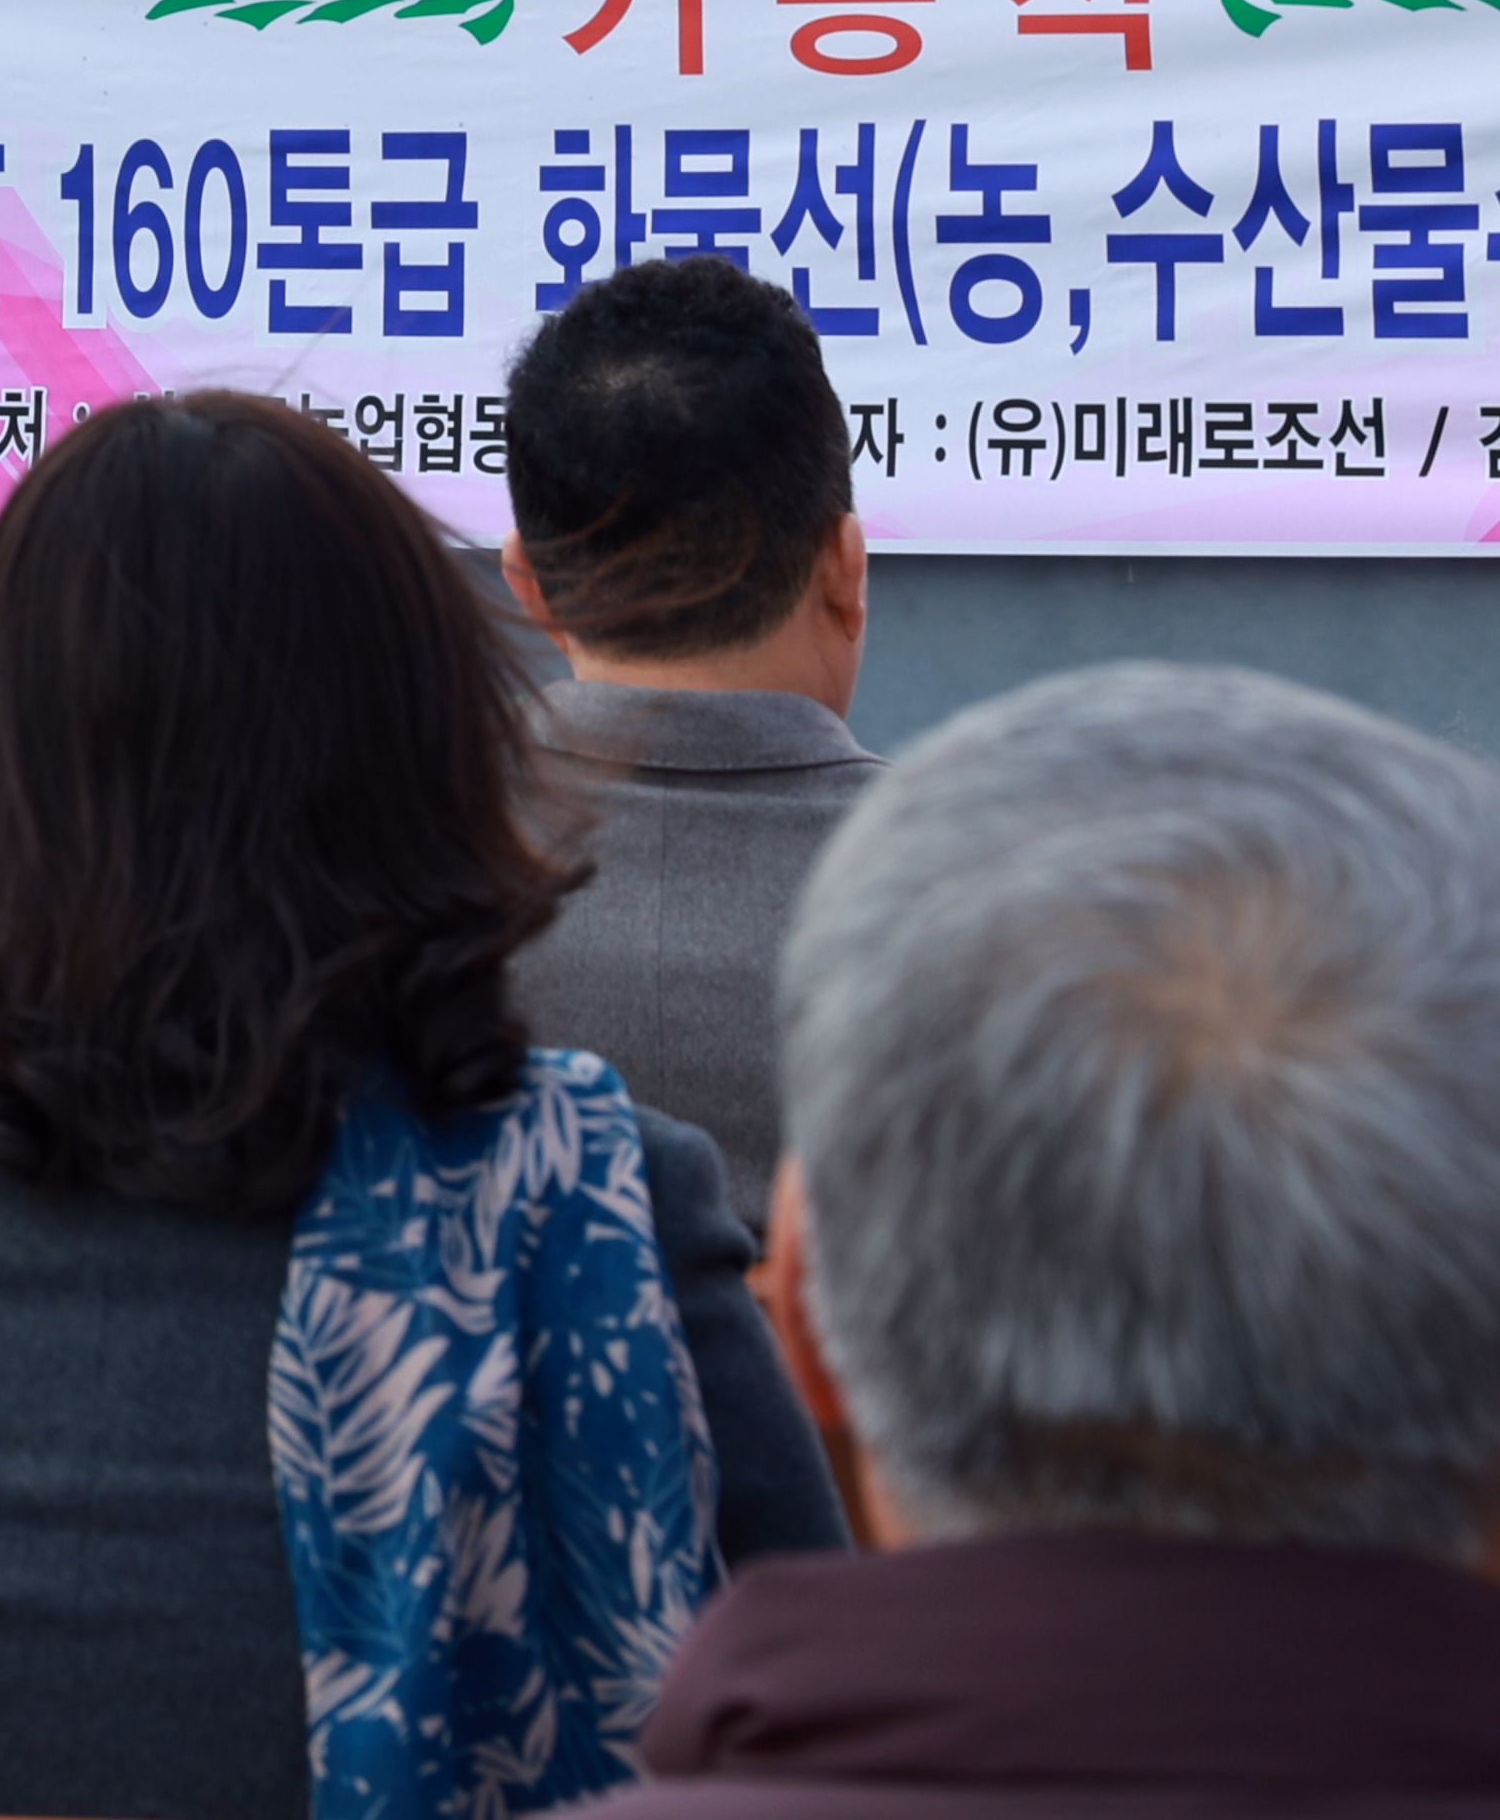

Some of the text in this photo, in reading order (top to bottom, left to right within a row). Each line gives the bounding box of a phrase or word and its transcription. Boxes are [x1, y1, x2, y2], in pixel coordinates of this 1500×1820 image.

[59, 129, 479, 338] 160톤급
[535, 118, 1500, 355] 화물선(농,수산물
[968, 396, 1386, 481] (유)미래로조선
